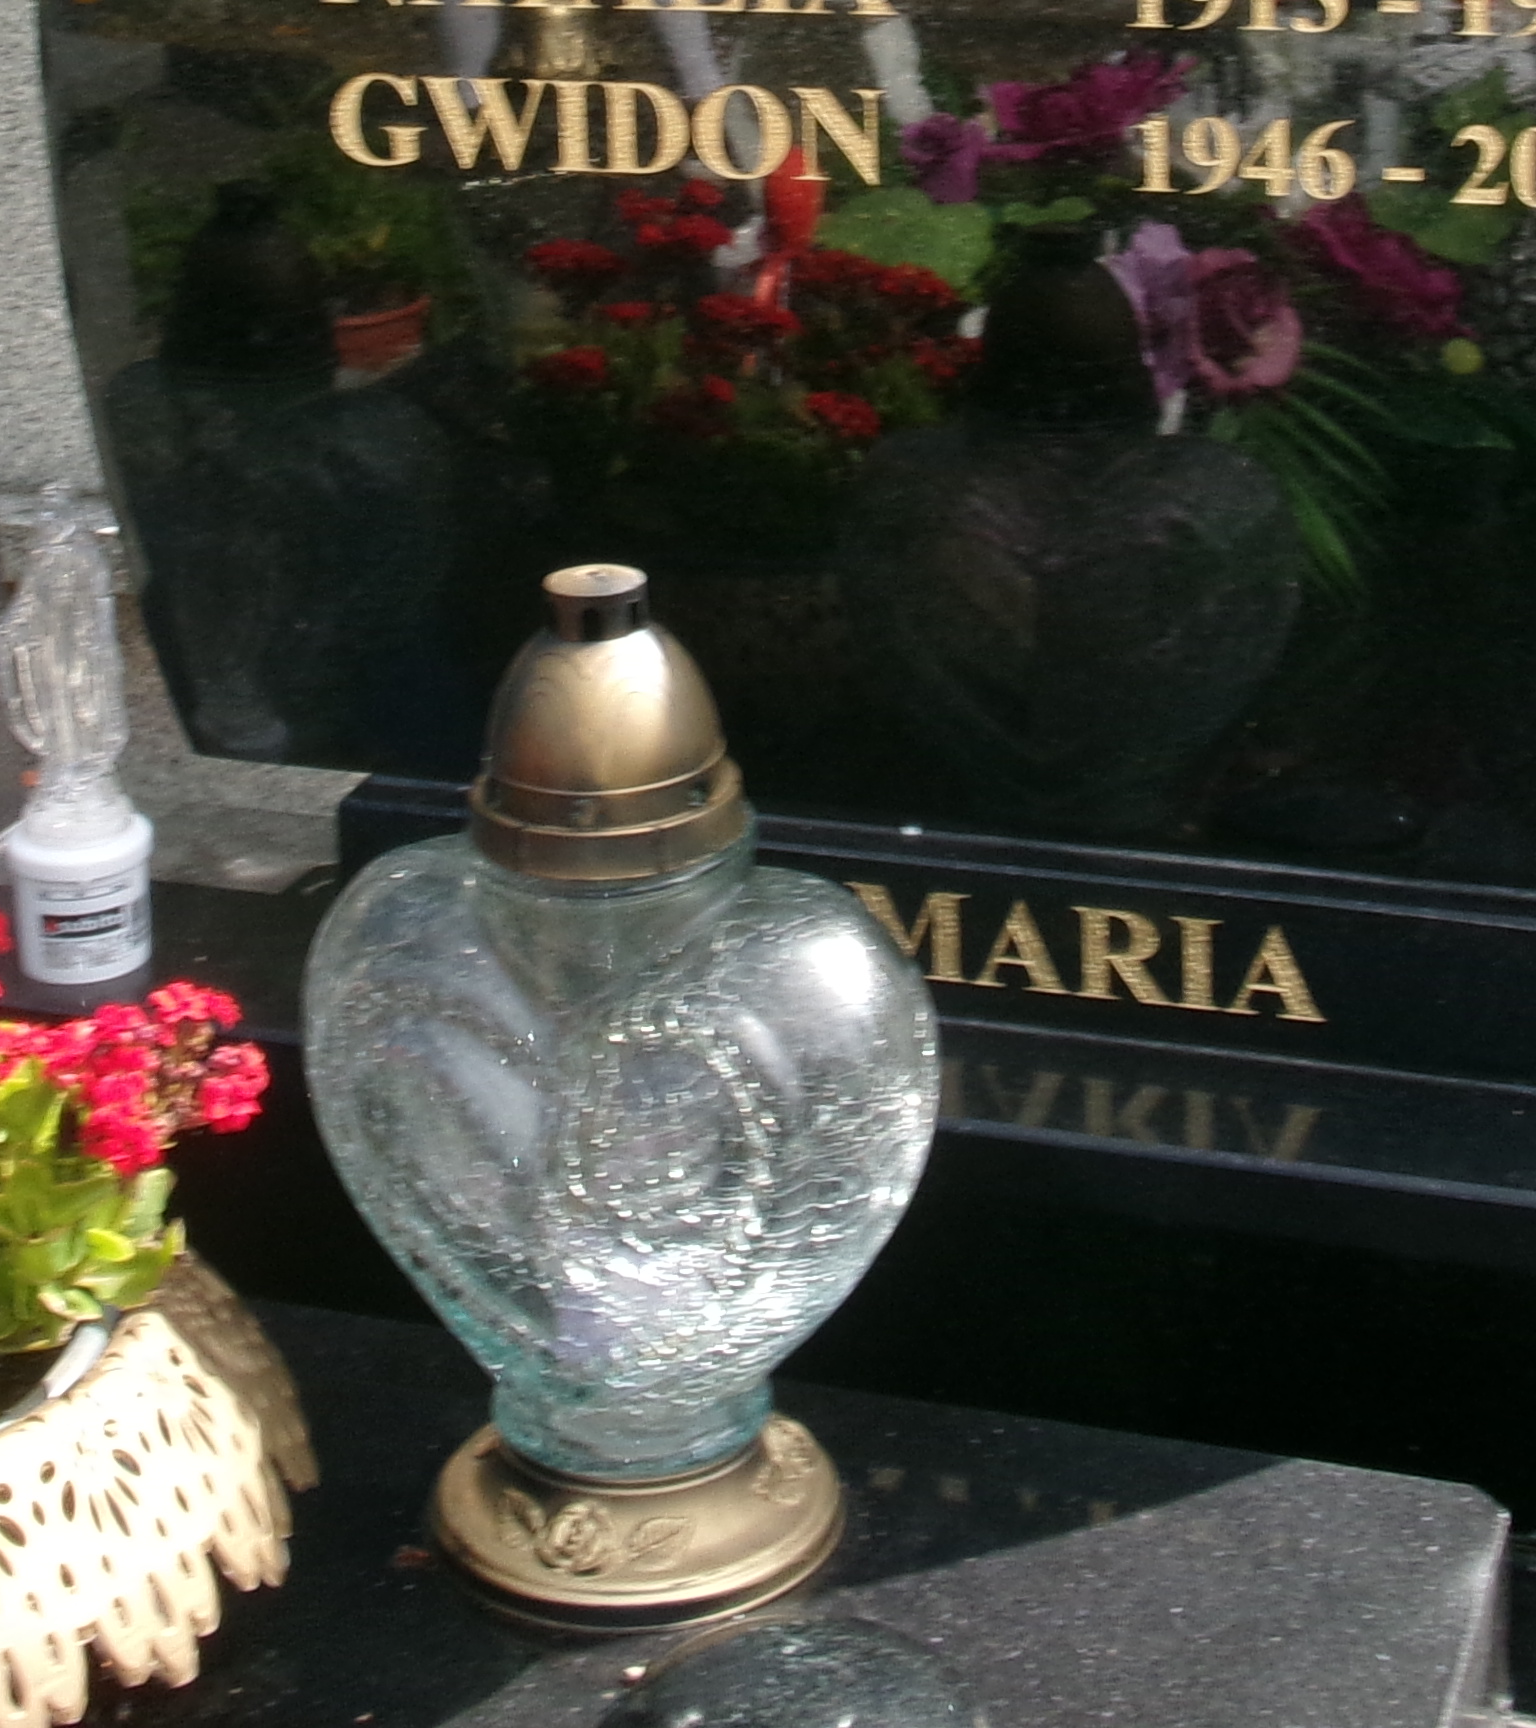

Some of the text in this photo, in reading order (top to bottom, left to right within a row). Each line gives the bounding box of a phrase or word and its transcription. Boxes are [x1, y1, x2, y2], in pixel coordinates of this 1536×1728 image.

[327, 71, 886, 188] GWIDON
[1133, 113, 1359, 203] 1946
[843, 881, 1328, 1023] MARIA
